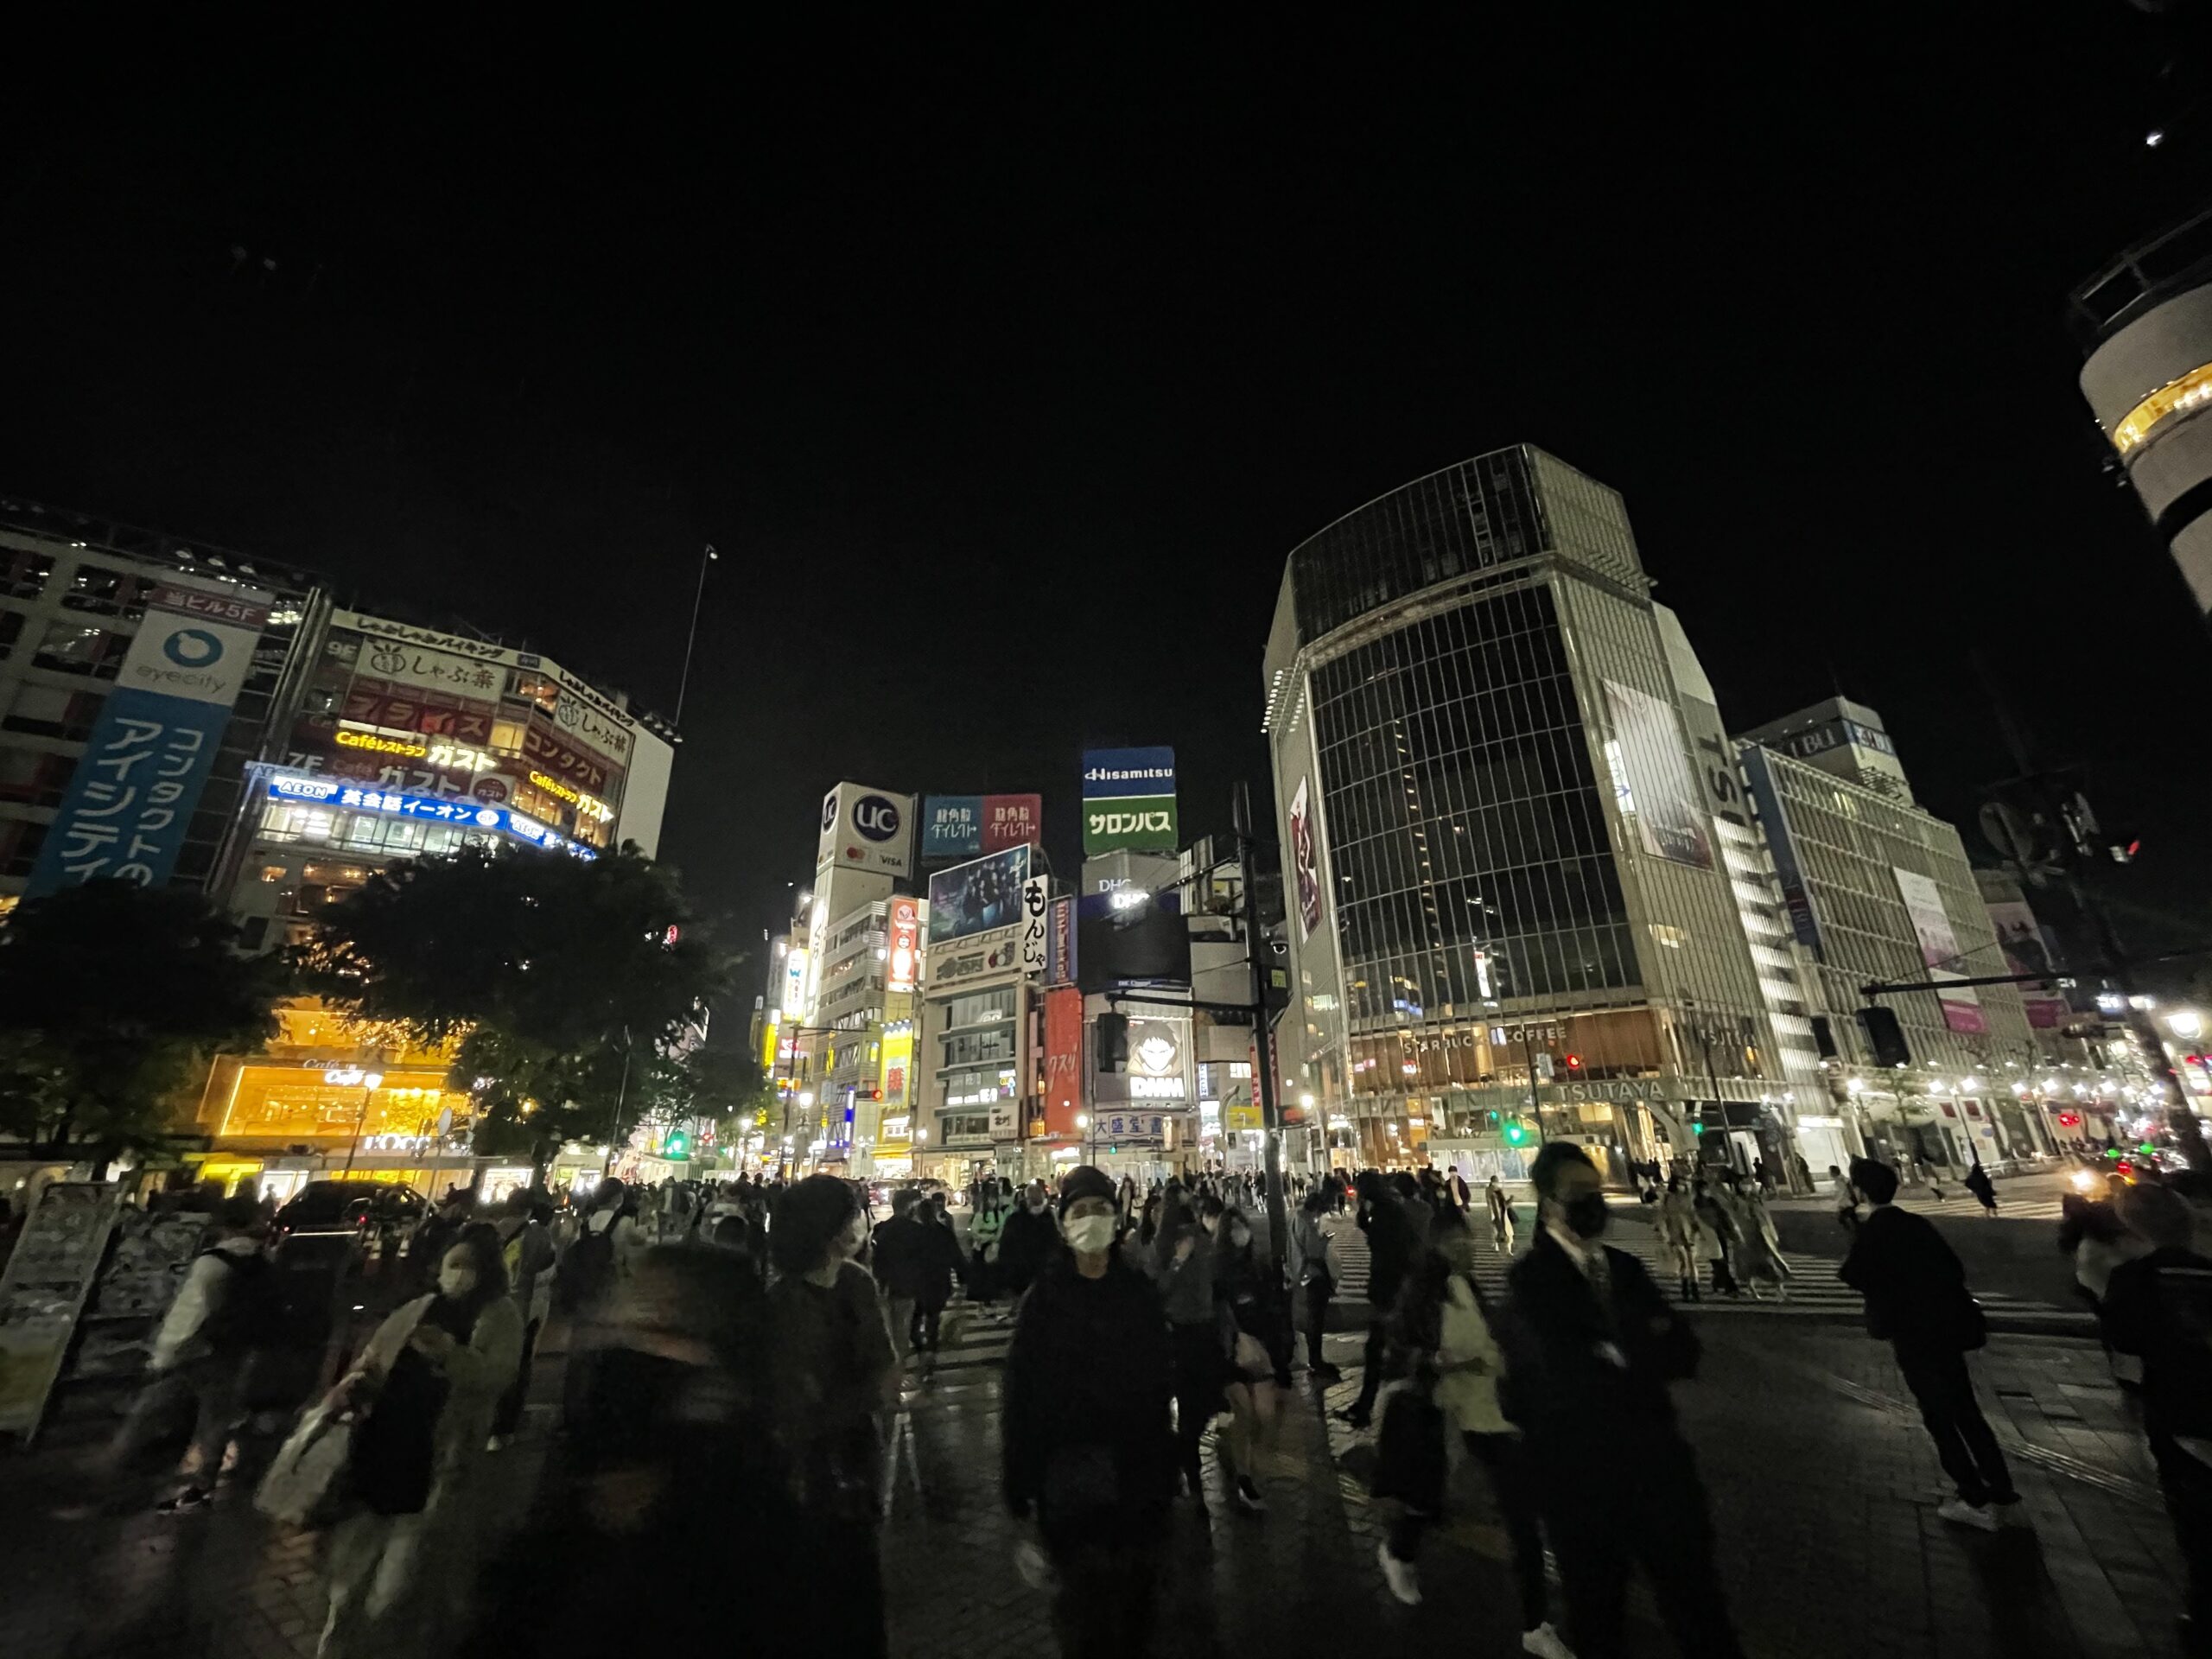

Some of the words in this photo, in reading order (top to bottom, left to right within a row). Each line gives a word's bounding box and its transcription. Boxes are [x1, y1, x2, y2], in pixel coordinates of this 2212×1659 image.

[163, 591, 257, 620] 当ビル5F
[136, 665, 226, 694] eyecity
[427, 744, 499, 772] ガスト
[526, 730, 602, 785] コンタクト
[1084, 767, 1173, 782] Hisamitsu
[60, 716, 163, 883] アイシティ
[278, 780, 329, 799] AEON
[340, 788, 472, 821] 英会話イーオン
[857, 803, 898, 833] UC
[1089, 810, 1172, 835] サロンパス
[880, 855, 902, 868] VISA
[1023, 880, 1046, 967] もんじゃ
[1506, 1027, 1567, 1043] COFFEE
[1129, 1076, 1185, 1098] DMM
[1556, 1080, 1664, 1102] TSUTAYA
[1095, 1116, 1163, 1135] 大盛堂書
